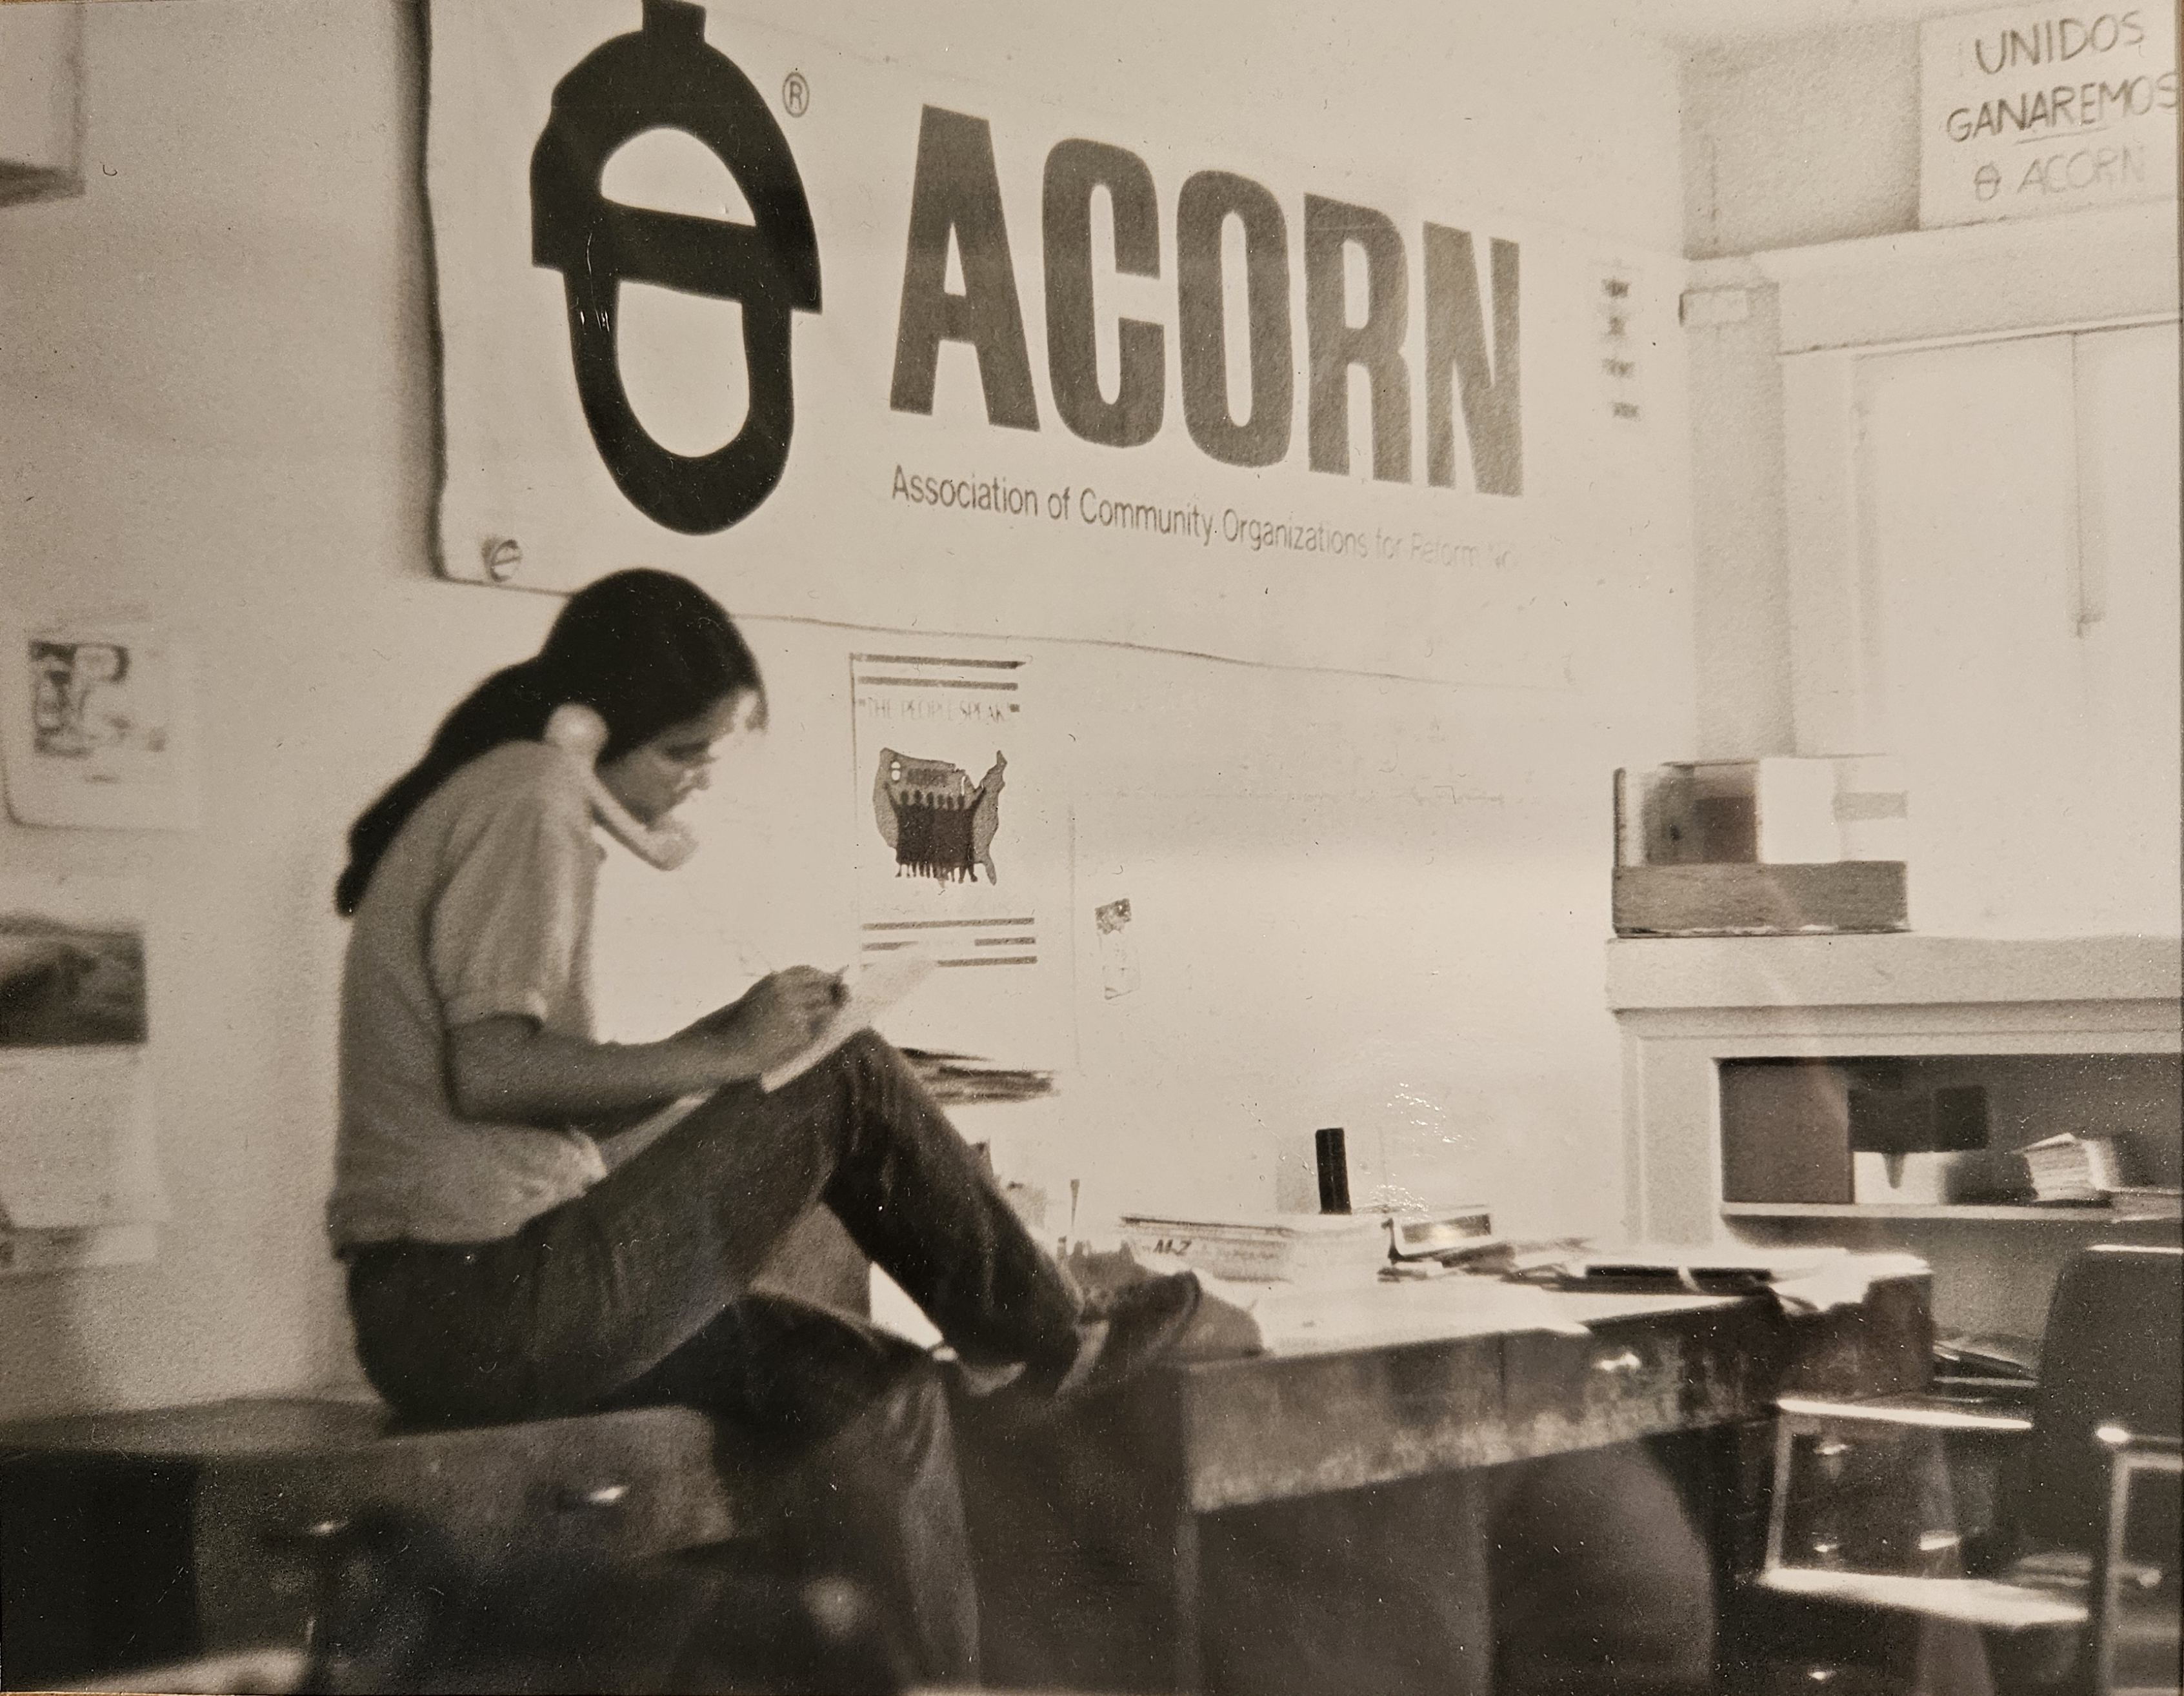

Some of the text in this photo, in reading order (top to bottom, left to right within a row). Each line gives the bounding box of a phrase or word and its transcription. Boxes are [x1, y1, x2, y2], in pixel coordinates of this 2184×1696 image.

[1975, 10, 2145, 75] UNIDOS
[1946, 69, 2177, 143] GANAREMOS
[890, 103, 1524, 498] ACORN
[892, 464, 1039, 516] Association
[1048, 486, 1071, 520] of
[1080, 488, 1213, 547] Community
[1223, 508, 1368, 560] Organizations
